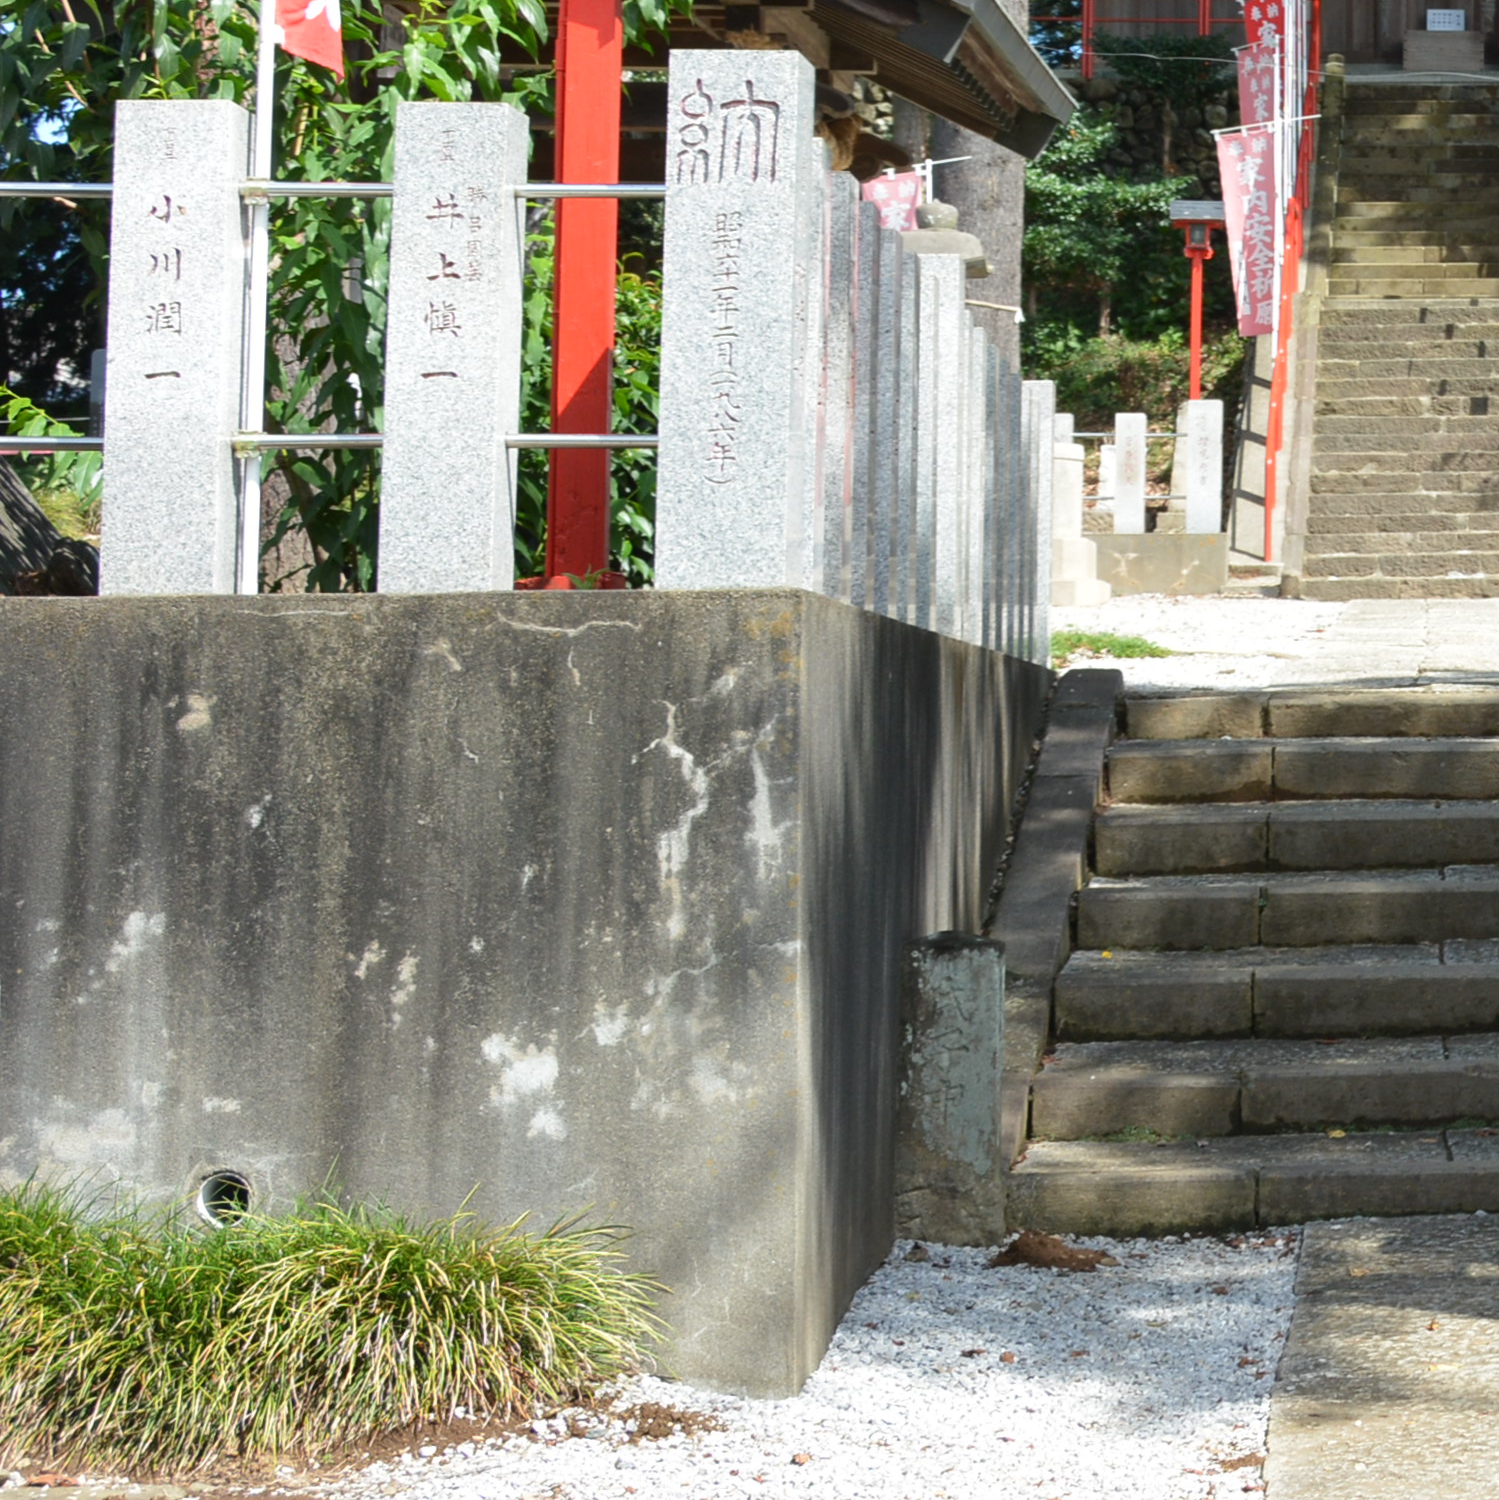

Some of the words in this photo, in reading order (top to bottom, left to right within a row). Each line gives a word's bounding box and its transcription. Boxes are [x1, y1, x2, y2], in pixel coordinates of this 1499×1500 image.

[1251, 2, 1279, 21] 奉納
[144, 194, 188, 379] 小川潤一
